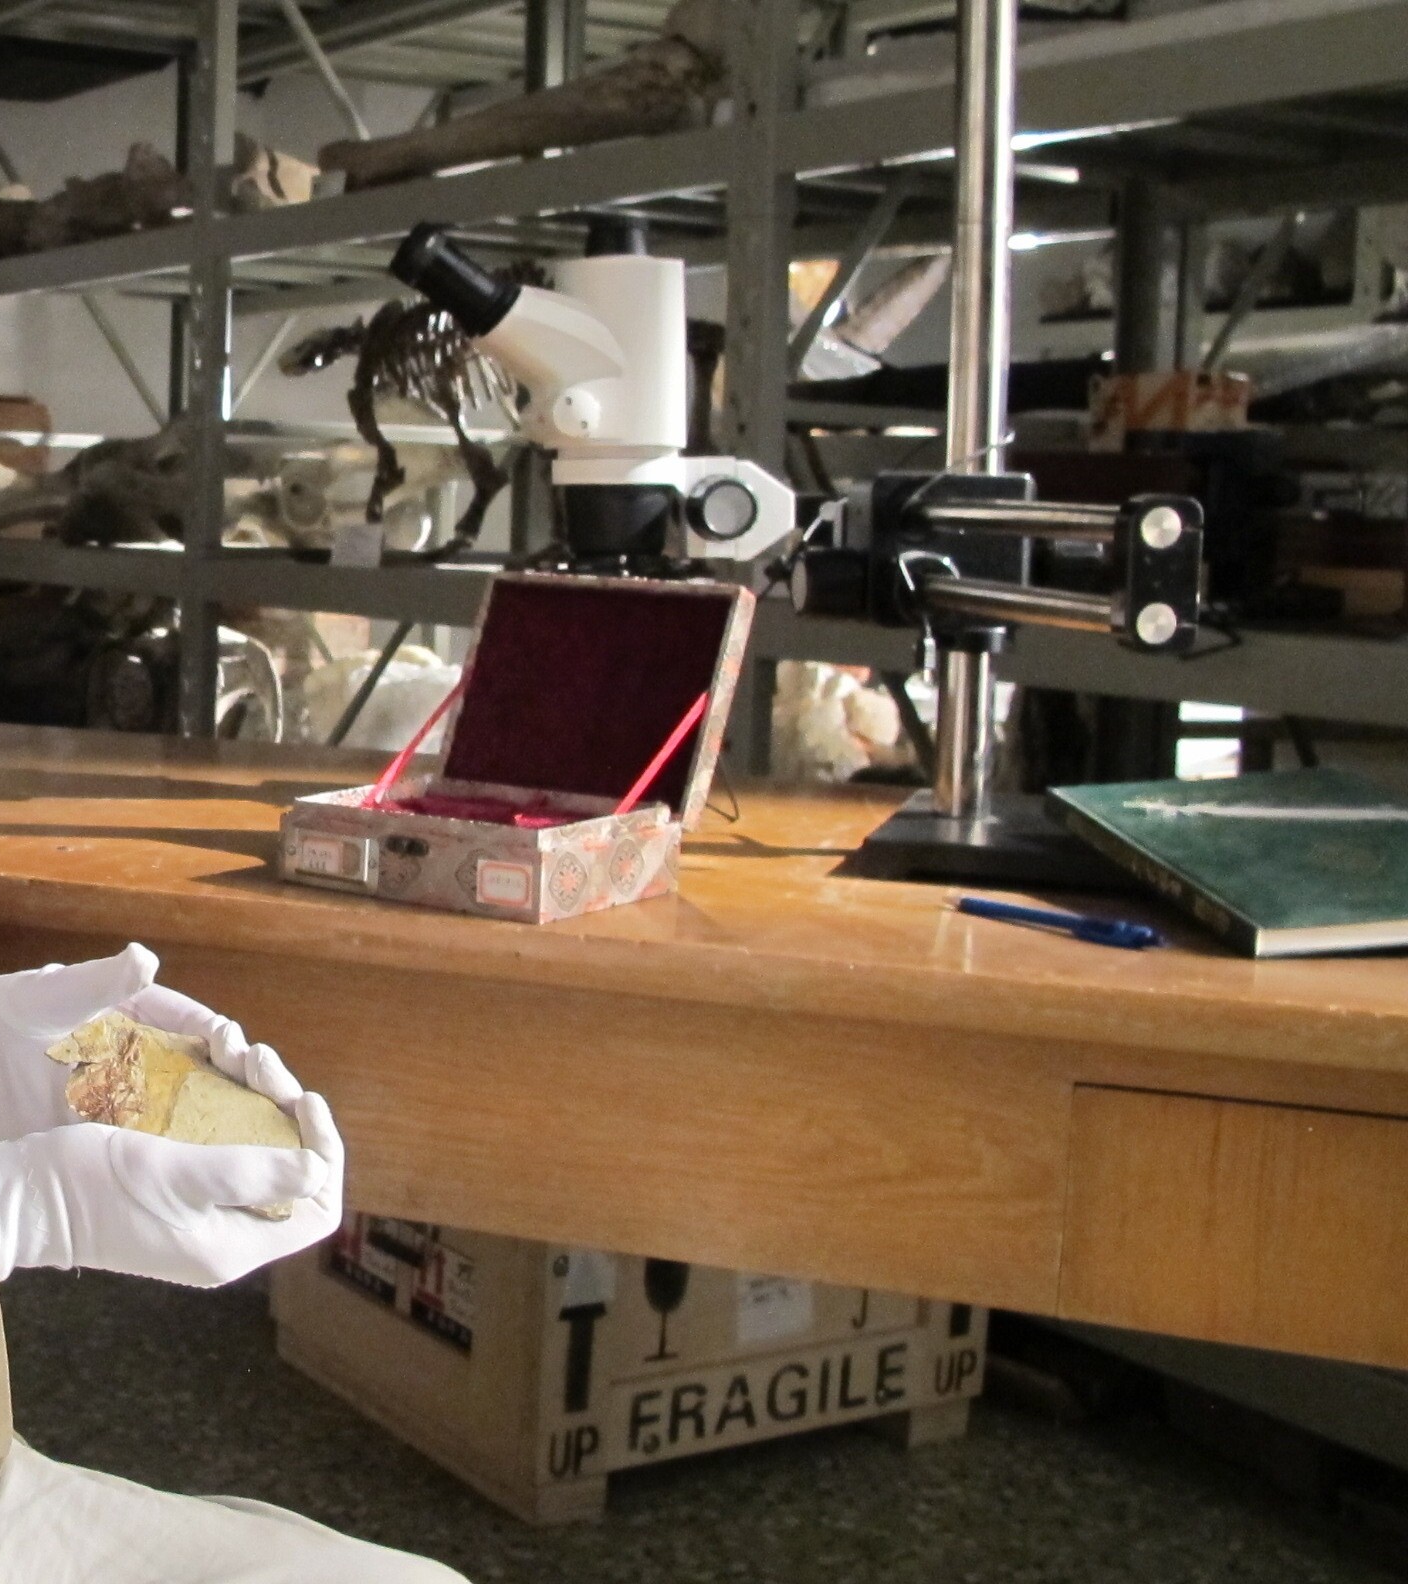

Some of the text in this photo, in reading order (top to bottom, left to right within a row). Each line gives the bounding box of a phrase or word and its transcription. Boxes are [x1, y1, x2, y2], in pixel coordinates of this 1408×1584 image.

[628, 1343, 907, 1451] FRAGILE
[935, 1349, 978, 1396] UP
[549, 1425, 600, 1477] UP
